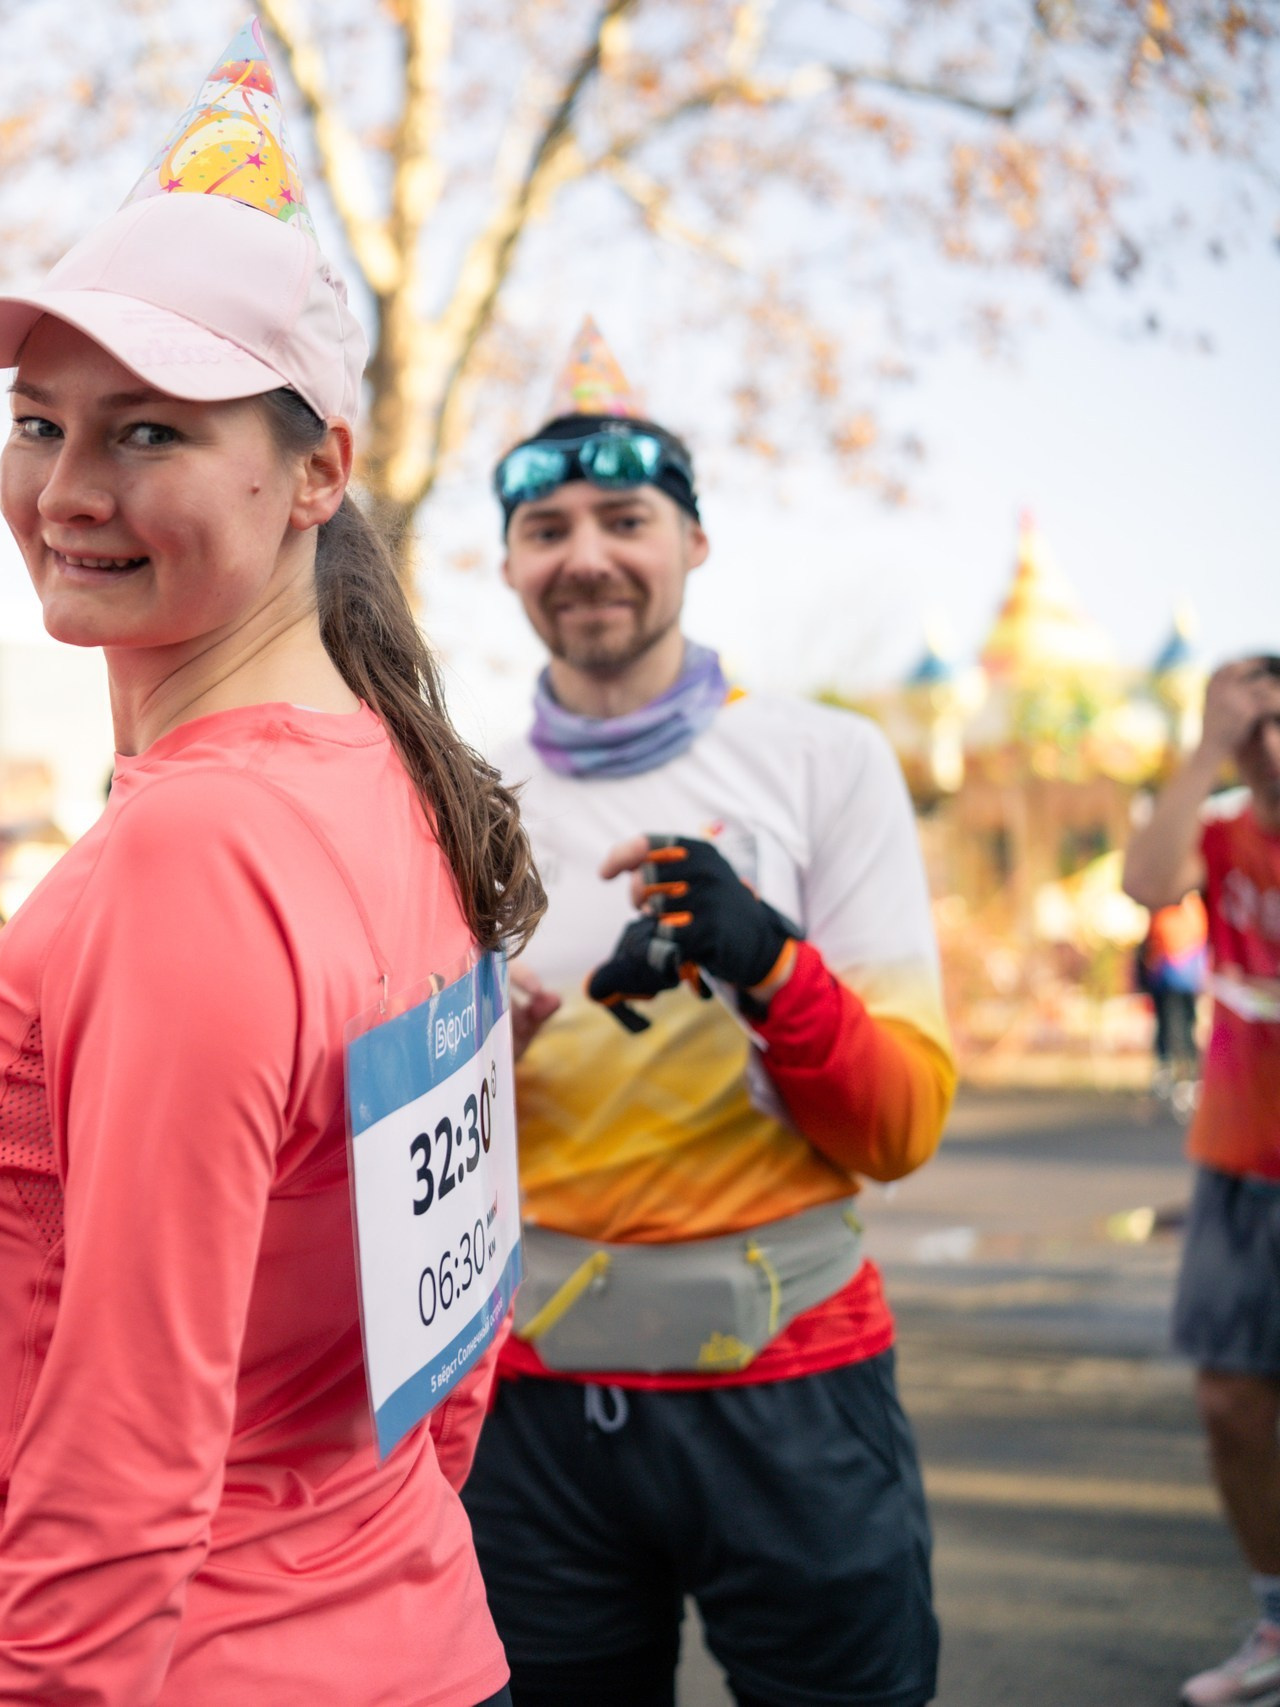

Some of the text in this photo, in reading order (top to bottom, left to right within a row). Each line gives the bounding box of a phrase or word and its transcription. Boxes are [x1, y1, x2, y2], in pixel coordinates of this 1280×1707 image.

[410, 1077, 491, 1216] 32:30
[419, 1218, 485, 1326] 06:30
[431, 1375, 437, 1393] 5
